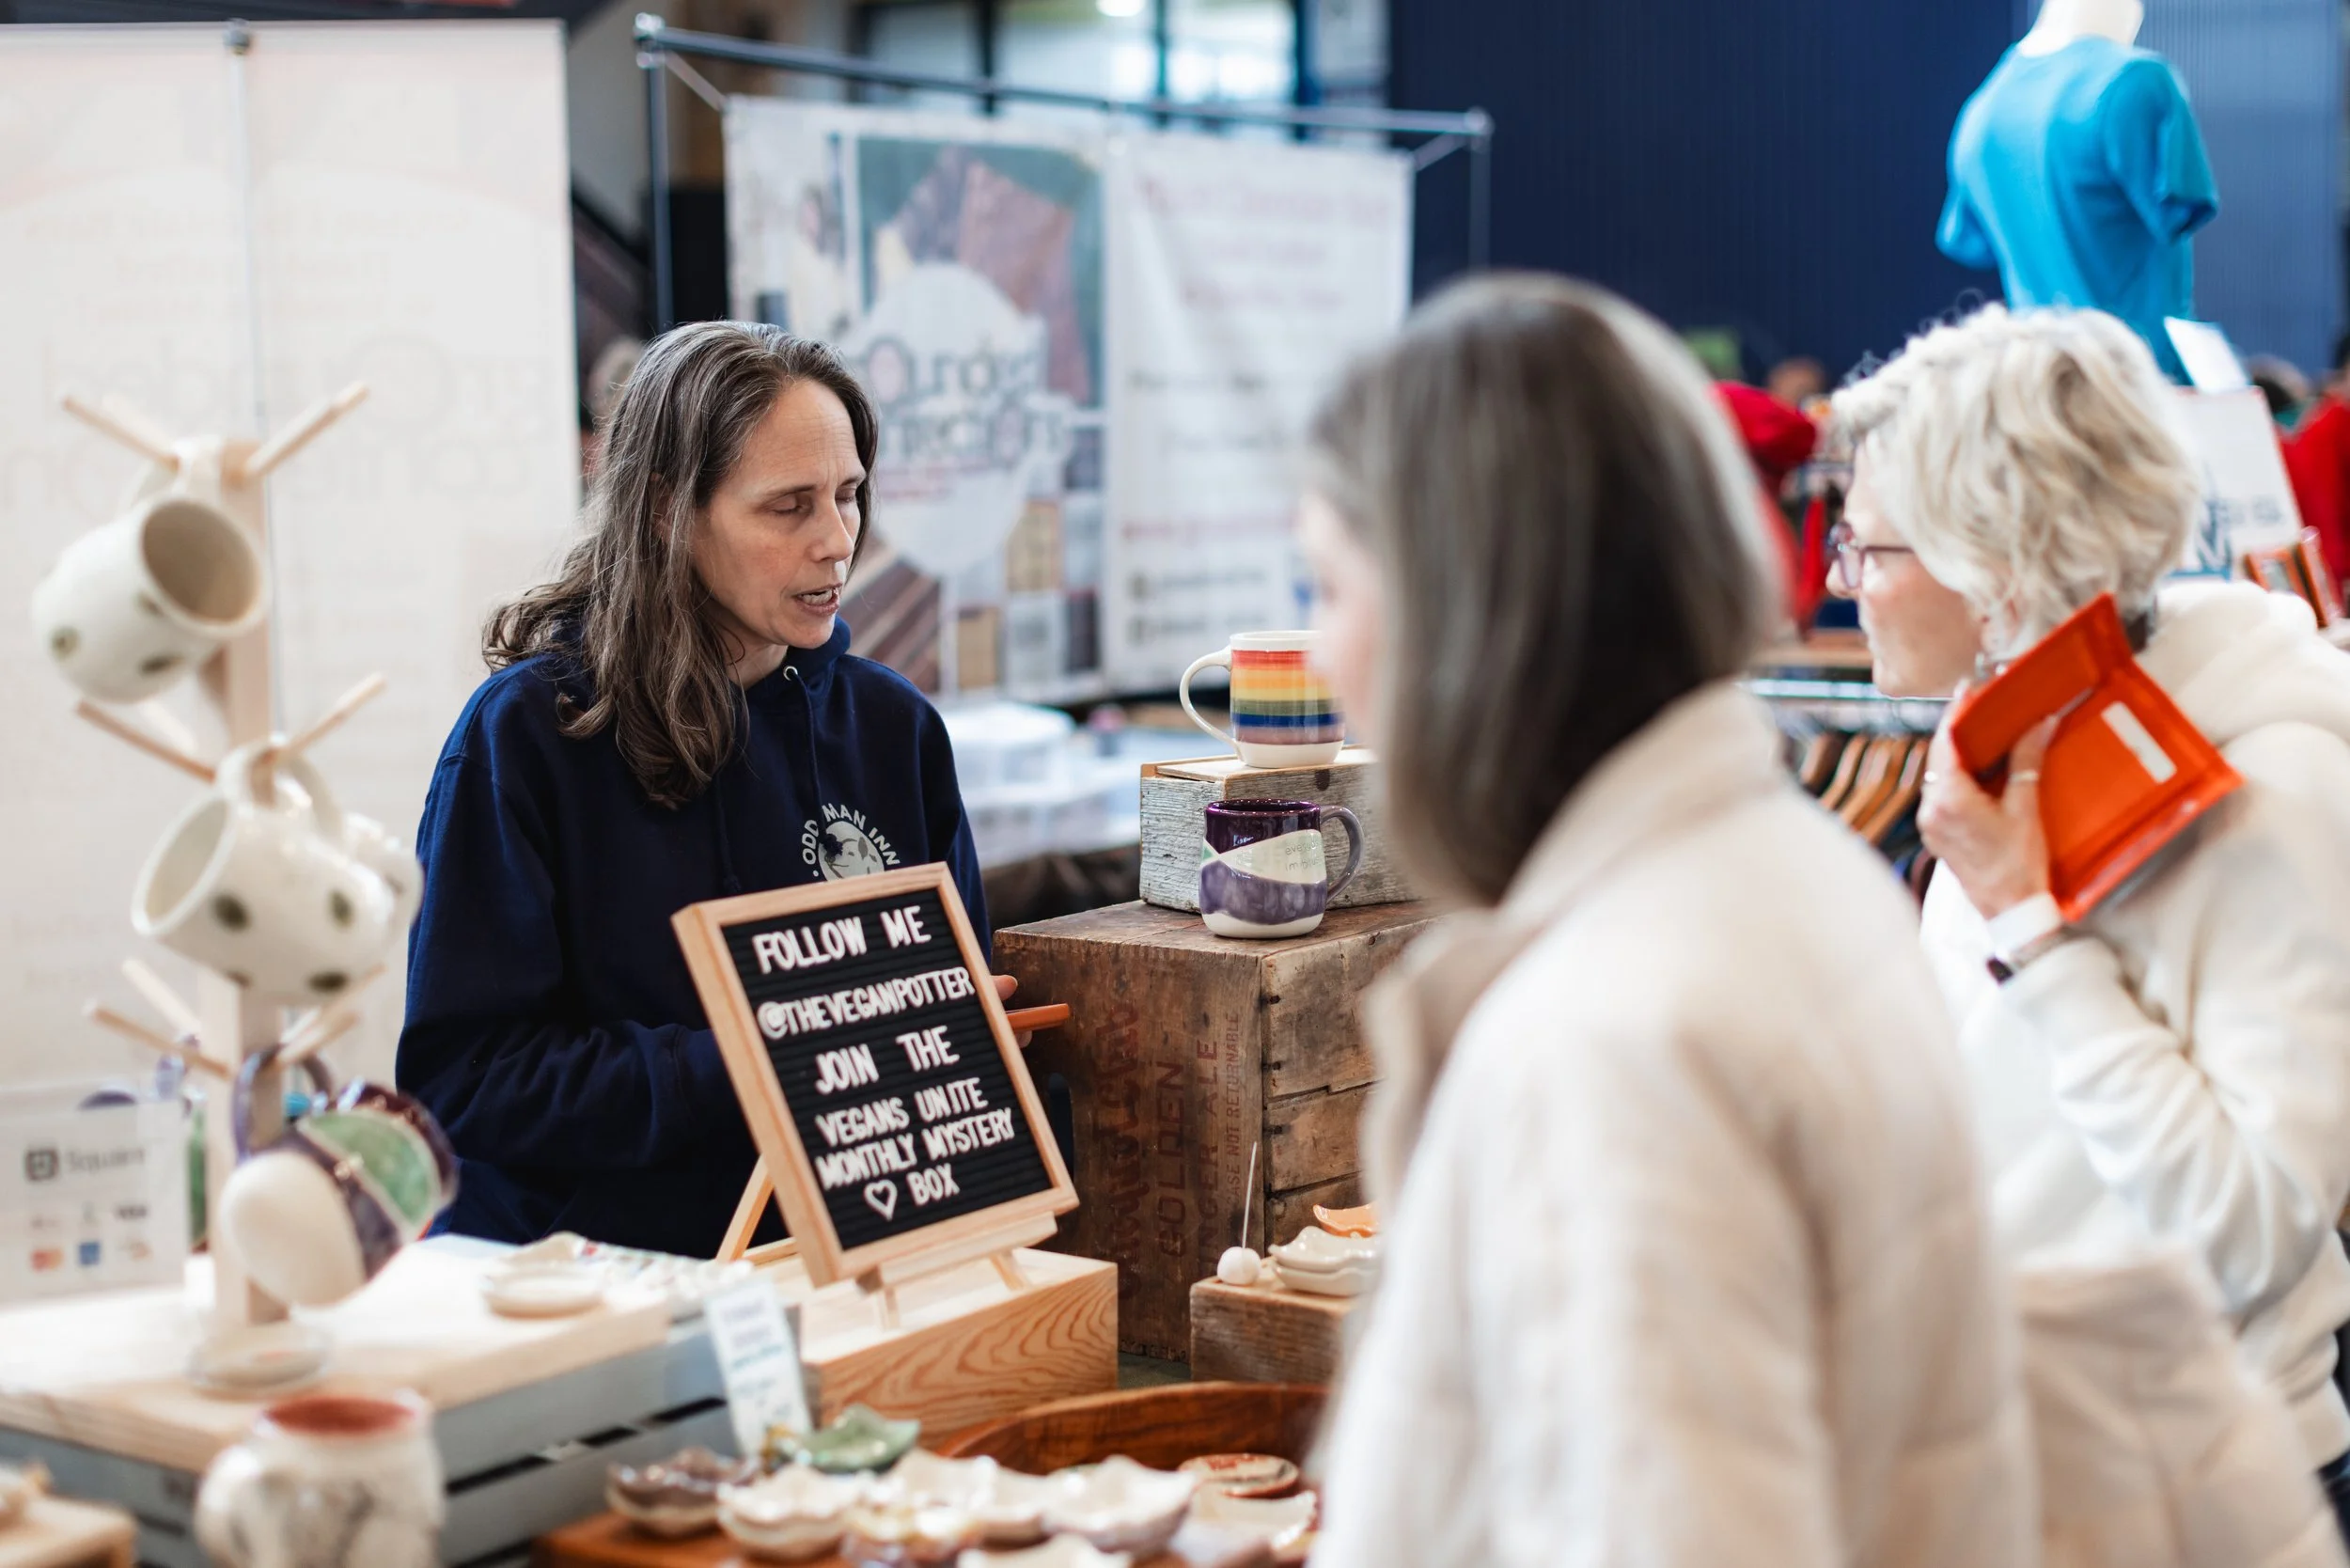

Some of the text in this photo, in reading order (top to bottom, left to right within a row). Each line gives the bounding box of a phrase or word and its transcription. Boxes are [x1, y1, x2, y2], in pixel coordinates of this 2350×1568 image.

[802, 803, 901, 866] ODD MAN INN
[752, 904, 932, 975] FOLLOW ME
[756, 965, 977, 1041] @THEVEGANPOTTER
[815, 1025, 961, 1095] JOIN THE
[1225, 1011, 1239, 1121] RETURNABLE
[815, 1076, 989, 1148] VEGANS UNITE
[1226, 1129, 1240, 1156] NOT
[814, 1106, 1016, 1191] MONTHLY MYSTERY
[906, 1162, 961, 1207] BOX
[1156, 1060, 1186, 1258] GOLDEN
[1197, 1038, 1219, 1271] INGER ALE
